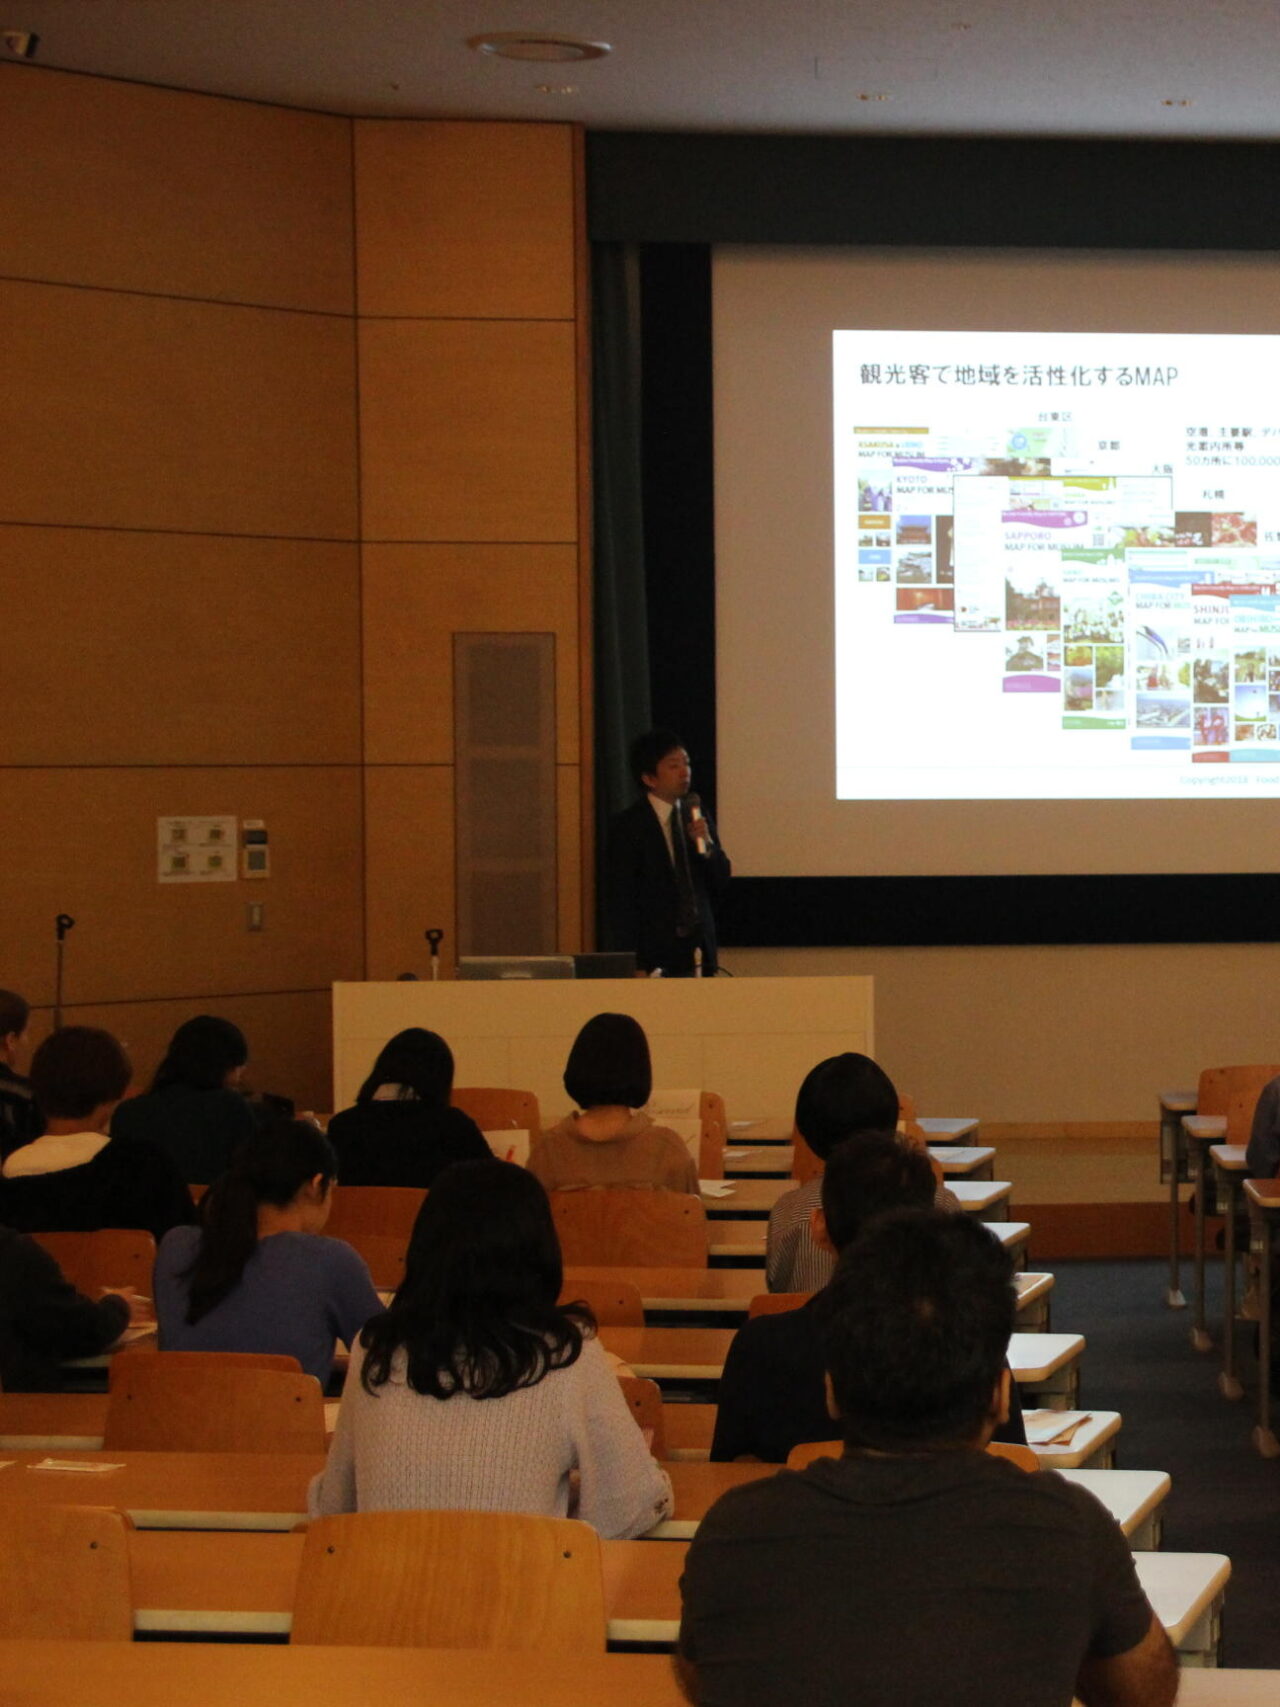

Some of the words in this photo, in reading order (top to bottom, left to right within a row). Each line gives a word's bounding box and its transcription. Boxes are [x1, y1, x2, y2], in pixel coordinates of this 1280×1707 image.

[1098, 440, 1121, 451] 京都
[896, 476, 928, 484] KYOTO
[896, 486, 916, 494] MAP
[1004, 531, 1052, 540] SAPPORO
[1004, 543, 1026, 551] MAP
